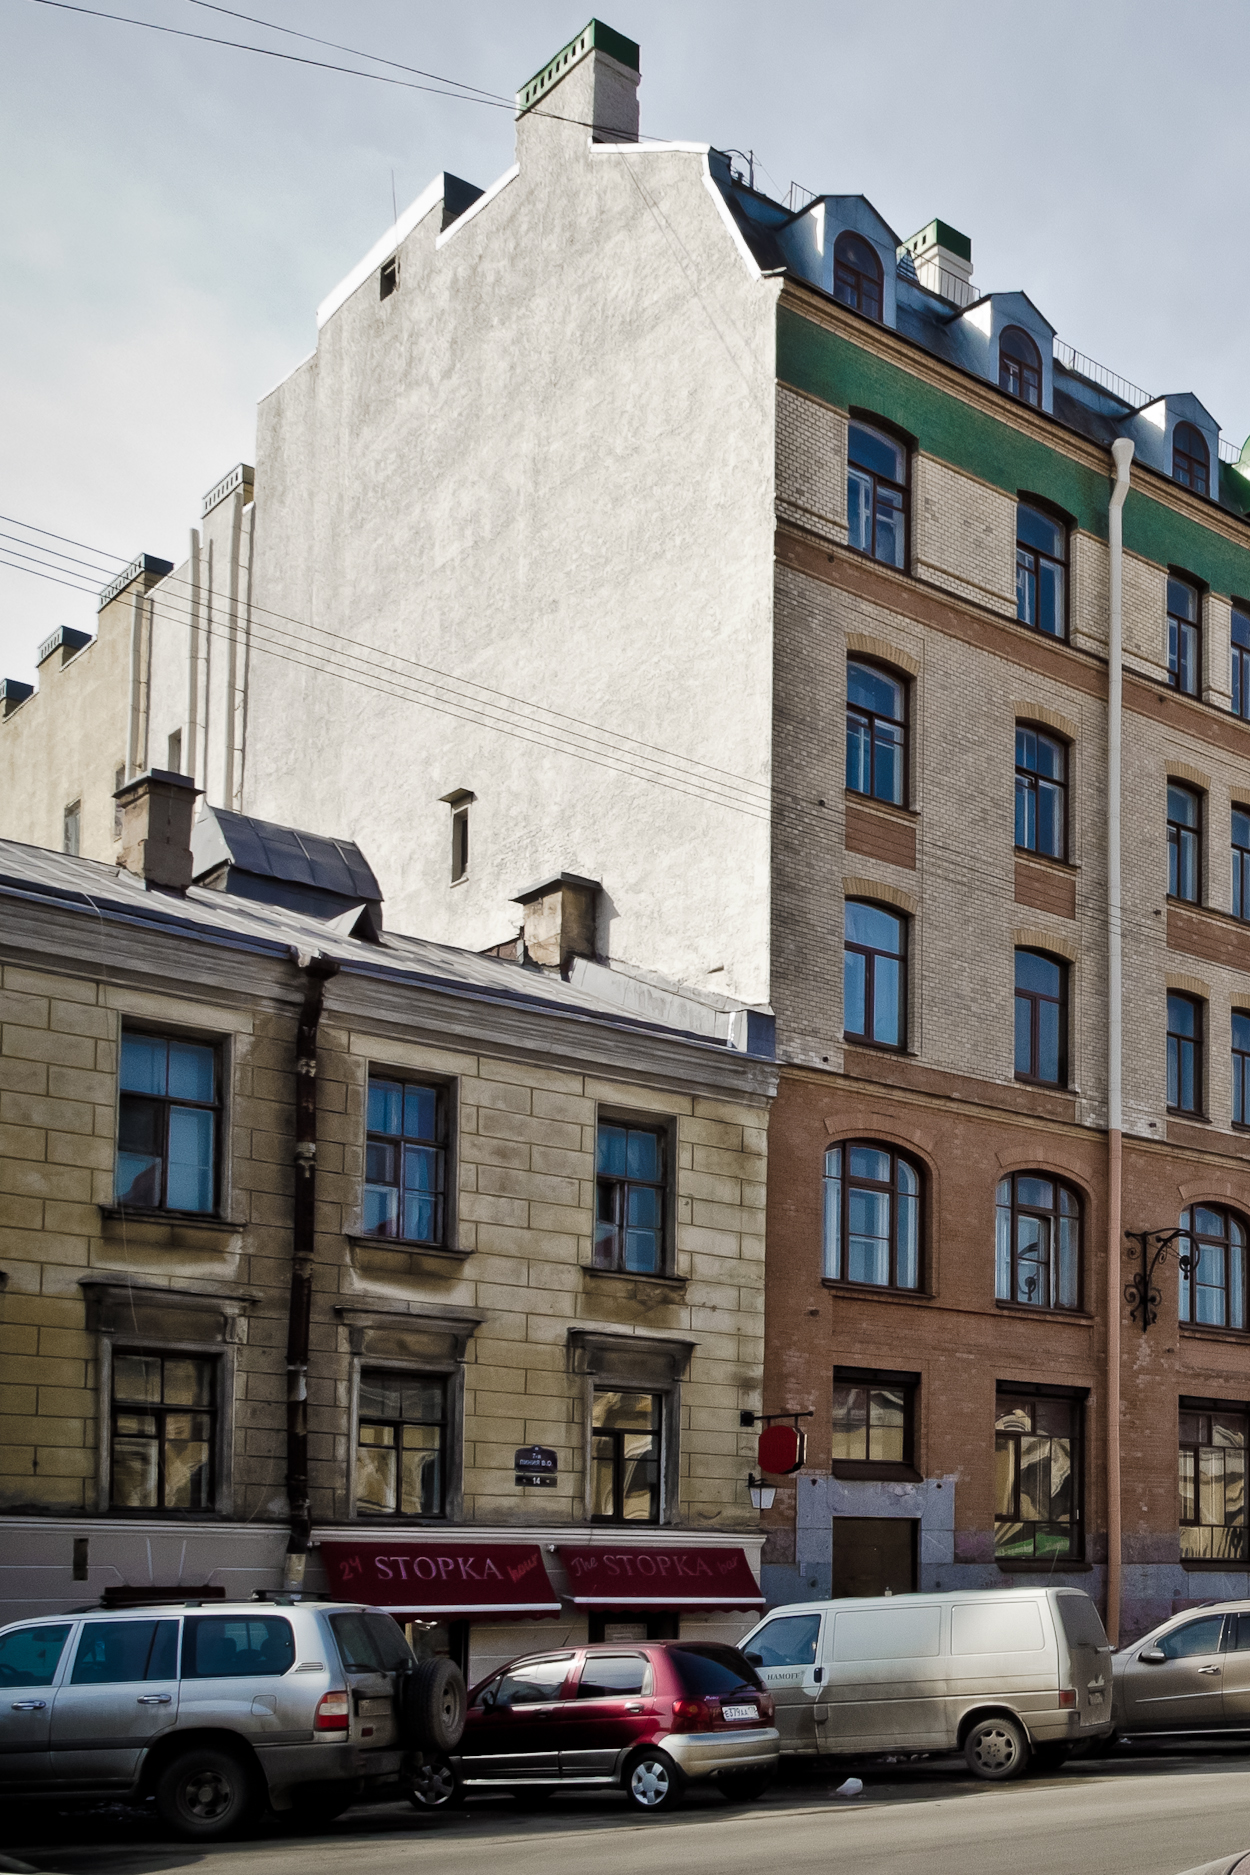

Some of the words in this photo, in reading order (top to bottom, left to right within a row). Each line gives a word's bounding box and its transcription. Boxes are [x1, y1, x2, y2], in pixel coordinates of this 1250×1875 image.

[532, 1476, 541, 1485] 14
[339, 1555, 363, 1581] 24
[374, 1556, 505, 1580] STOPKA
[507, 1552, 539, 1583] hour
[571, 1555, 599, 1577] The
[603, 1555, 714, 1576] STOPKA
[717, 1556, 739, 1575] bar
